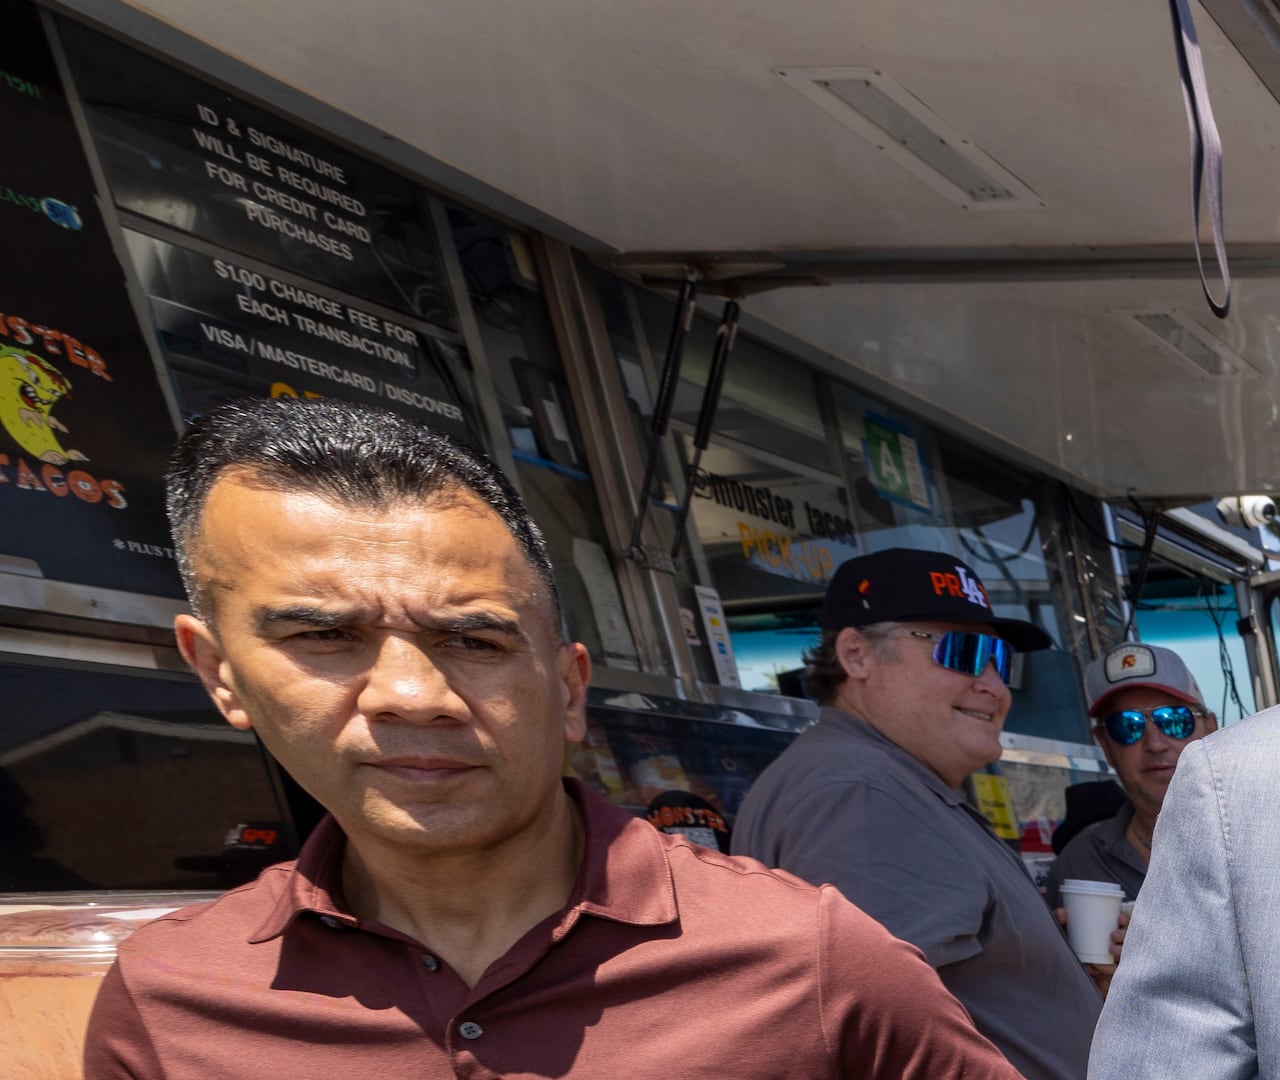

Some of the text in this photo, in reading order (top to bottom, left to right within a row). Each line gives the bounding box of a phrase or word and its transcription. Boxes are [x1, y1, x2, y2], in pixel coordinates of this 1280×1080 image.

[192, 128, 366, 217] WILL BE REQUIRED
[197, 104, 348, 184] ID & SIGNATURE
[204, 160, 371, 243] FOR CREDIT CARD
[245, 205, 354, 261] PURCHASES
[0, 313, 113, 382] STER
[236, 294, 417, 370] EACH TRANSACTION.
[269, 280, 346, 320] CHARGE
[348, 307, 382, 333] FEE
[383, 322, 419, 347] FOR
[200, 322, 249, 353] VISA
[257, 340, 378, 394] MASTERCARD
[384, 382, 465, 422] DISCOVER
[880, 439, 902, 485] A
[127, 541, 162, 559] PLUS
[737, 521, 833, 582] PICK-UP
[804, 501, 858, 549] tacos
